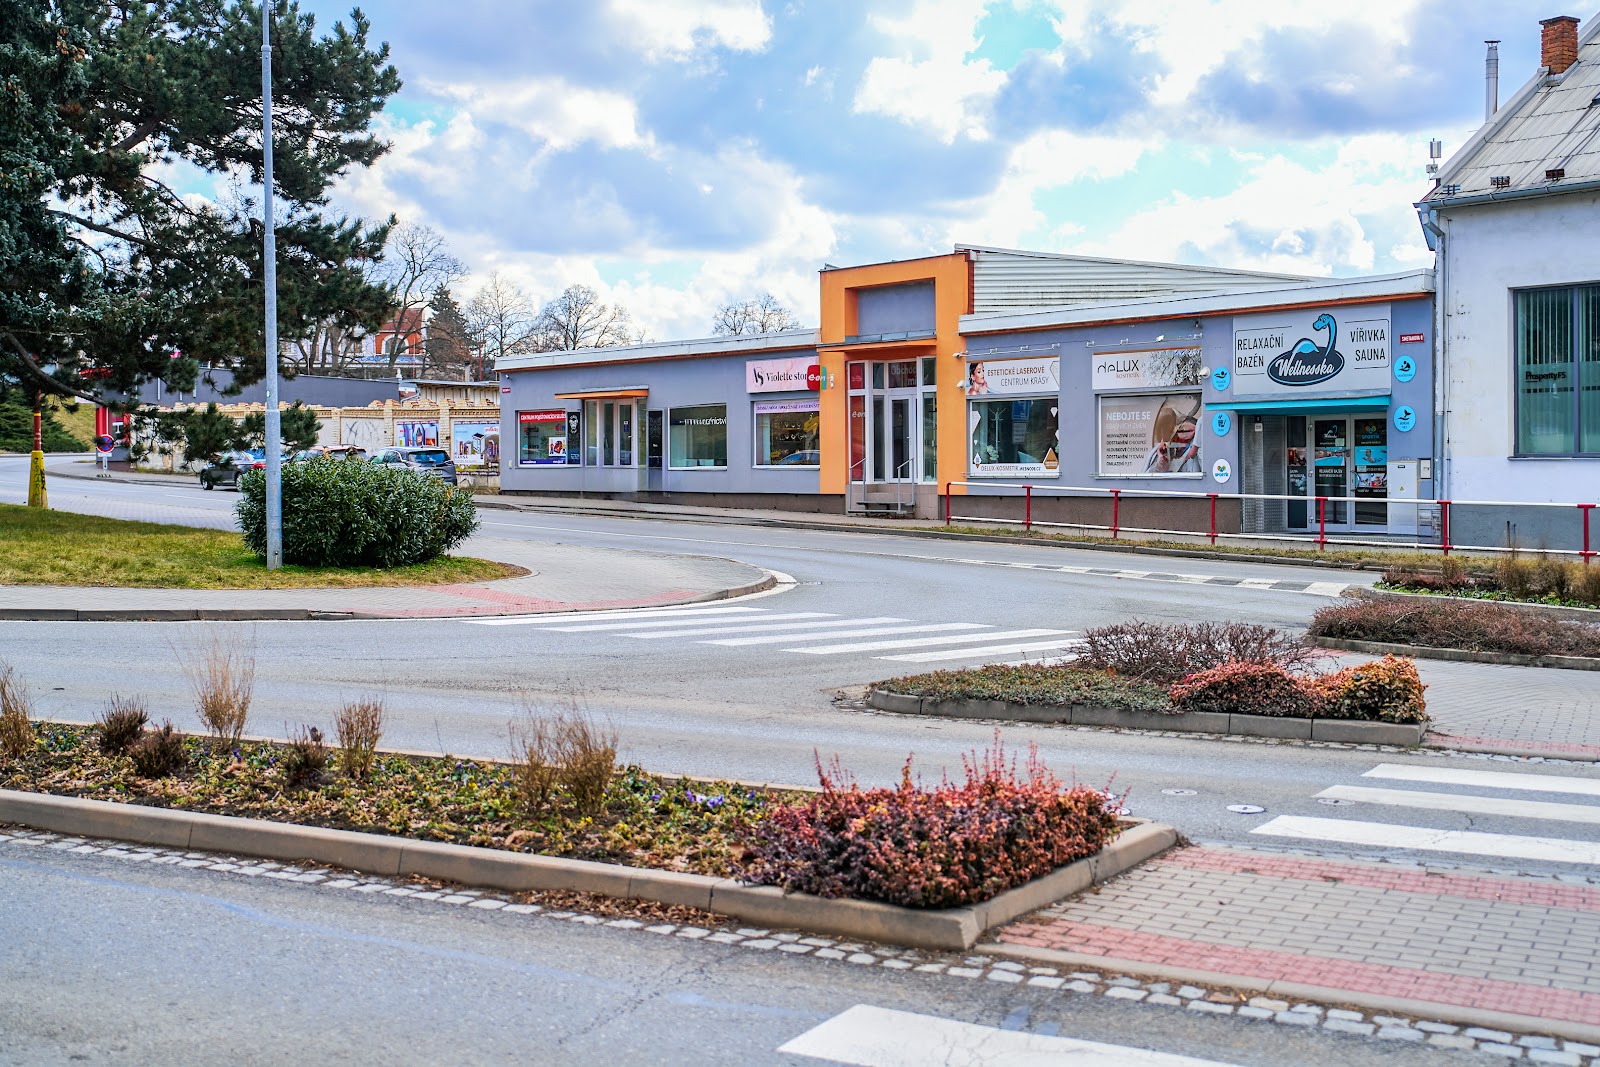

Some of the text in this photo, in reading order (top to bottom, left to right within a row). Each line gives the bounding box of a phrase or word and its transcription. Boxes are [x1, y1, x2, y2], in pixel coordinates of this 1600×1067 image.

[1237, 333, 1284, 351] RELAXAČNÍ
[1350, 327, 1386, 343] VÍŘIVKA
[1237, 352, 1264, 368] BAZÉN
[1355, 347, 1386, 361] SAUNA
[987, 364, 1045, 377] ESTETICKÉ LASEROVÉ
[1275, 357, 1335, 377] Wellnesska
[766, 371, 808, 382] Violette stor
[1001, 375, 1049, 387] CENTRUM KRÁSY
[1106, 411, 1151, 421] NEBOJTE SE
